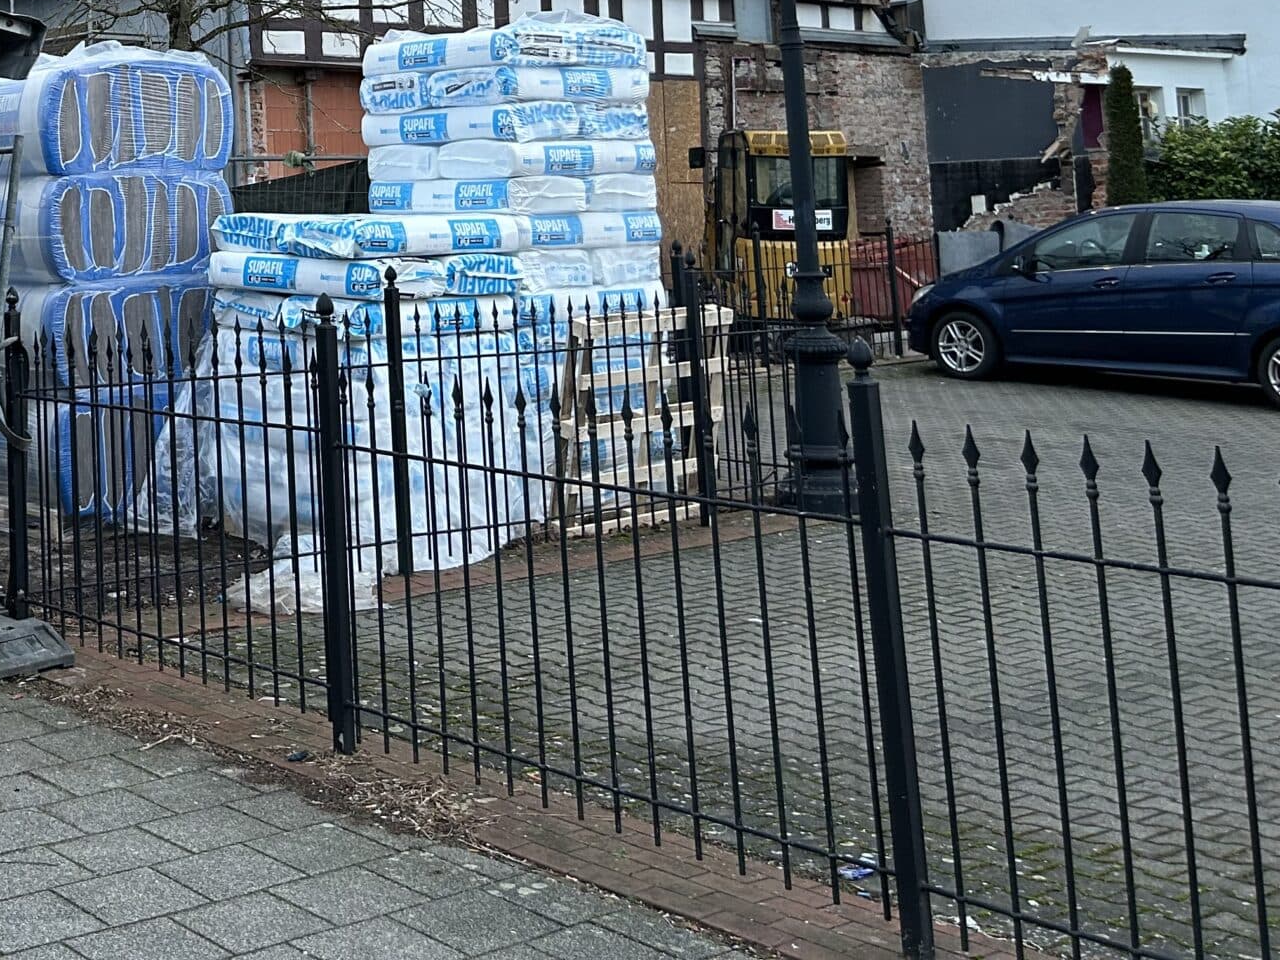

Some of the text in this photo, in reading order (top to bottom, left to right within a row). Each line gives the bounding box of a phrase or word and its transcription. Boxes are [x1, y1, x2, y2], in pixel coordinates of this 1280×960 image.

[401, 42, 434, 57] SUPAFIL
[403, 116, 435, 131] SUPAFIL
[549, 149, 582, 162] SUPAFIL
[371, 185, 402, 198] SUPAFIL
[459, 183, 493, 197] SUPAFIL
[453, 223, 488, 236] SUPAFIL
[534, 218, 570, 232] SUPAFIL
[247, 259, 284, 275] SUPAFIL
